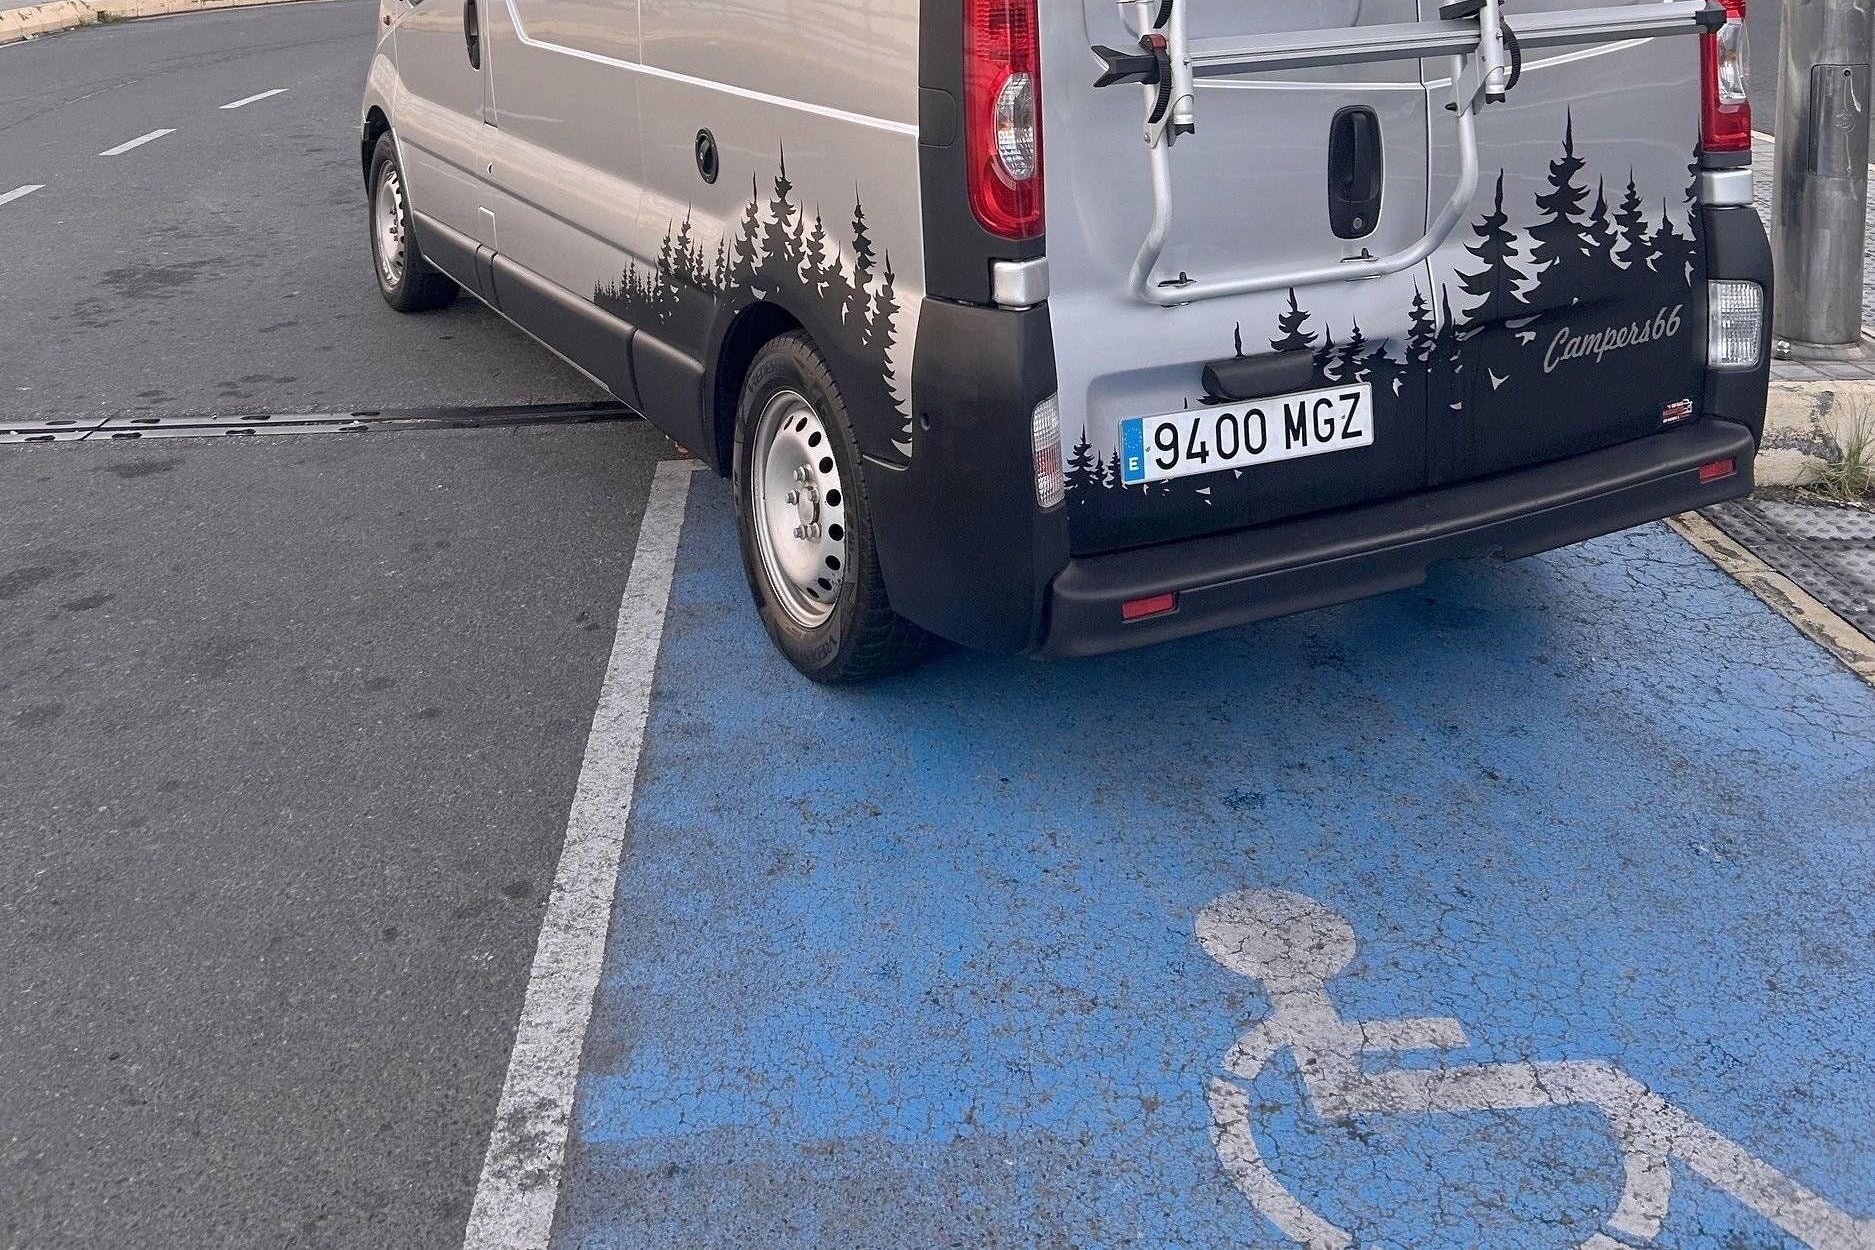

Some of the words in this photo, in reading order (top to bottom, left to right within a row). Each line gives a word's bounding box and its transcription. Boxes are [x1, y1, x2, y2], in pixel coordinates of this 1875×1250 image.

[1543, 304, 1684, 374] Campers66
[1128, 456, 1139, 471] E
[1154, 408, 1267, 470] 9400
[1283, 392, 1363, 450] MGZ
